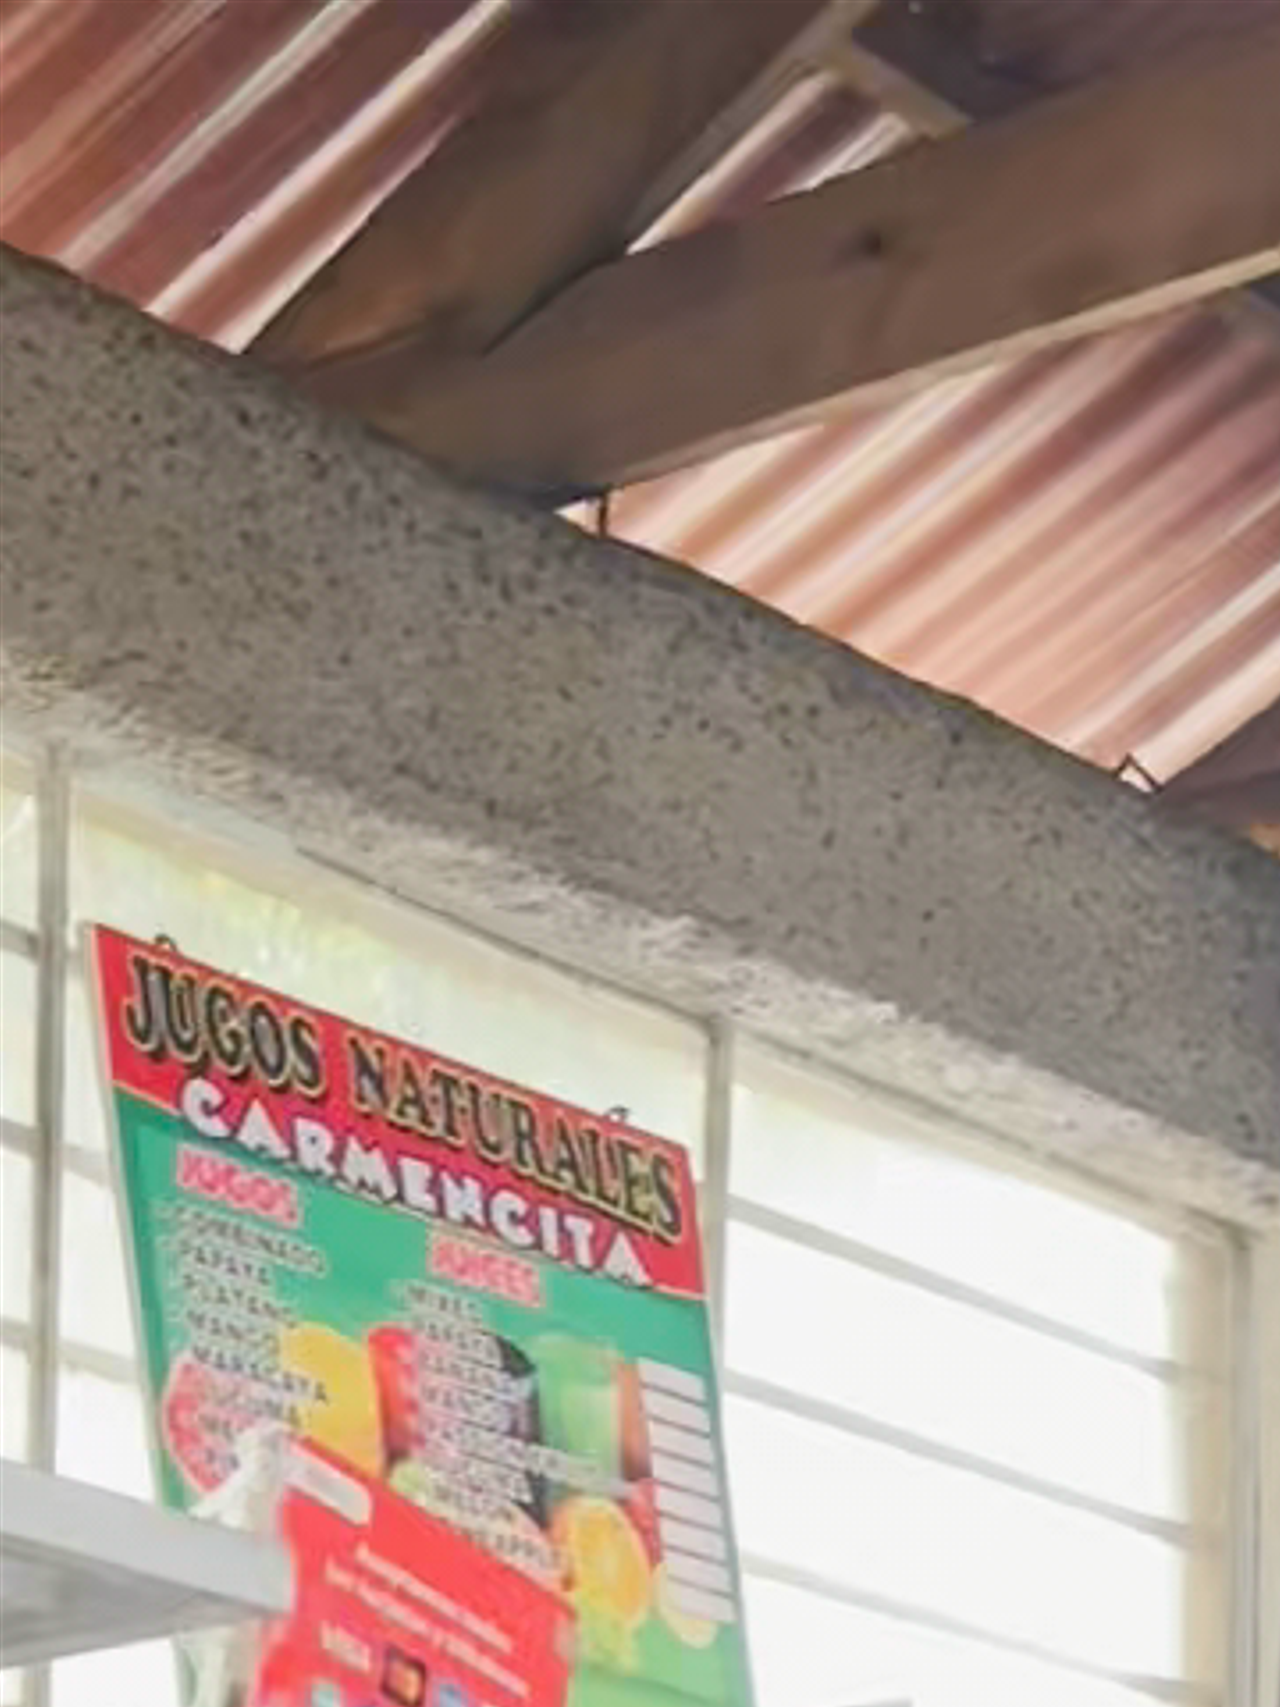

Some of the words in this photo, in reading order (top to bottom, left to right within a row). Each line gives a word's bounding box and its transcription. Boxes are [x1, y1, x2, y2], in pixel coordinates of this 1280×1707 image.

[124, 953, 322, 1090] JUGOS
[347, 1036, 681, 1234] NATURALES
[182, 1076, 650, 1285] CARMENCITA
